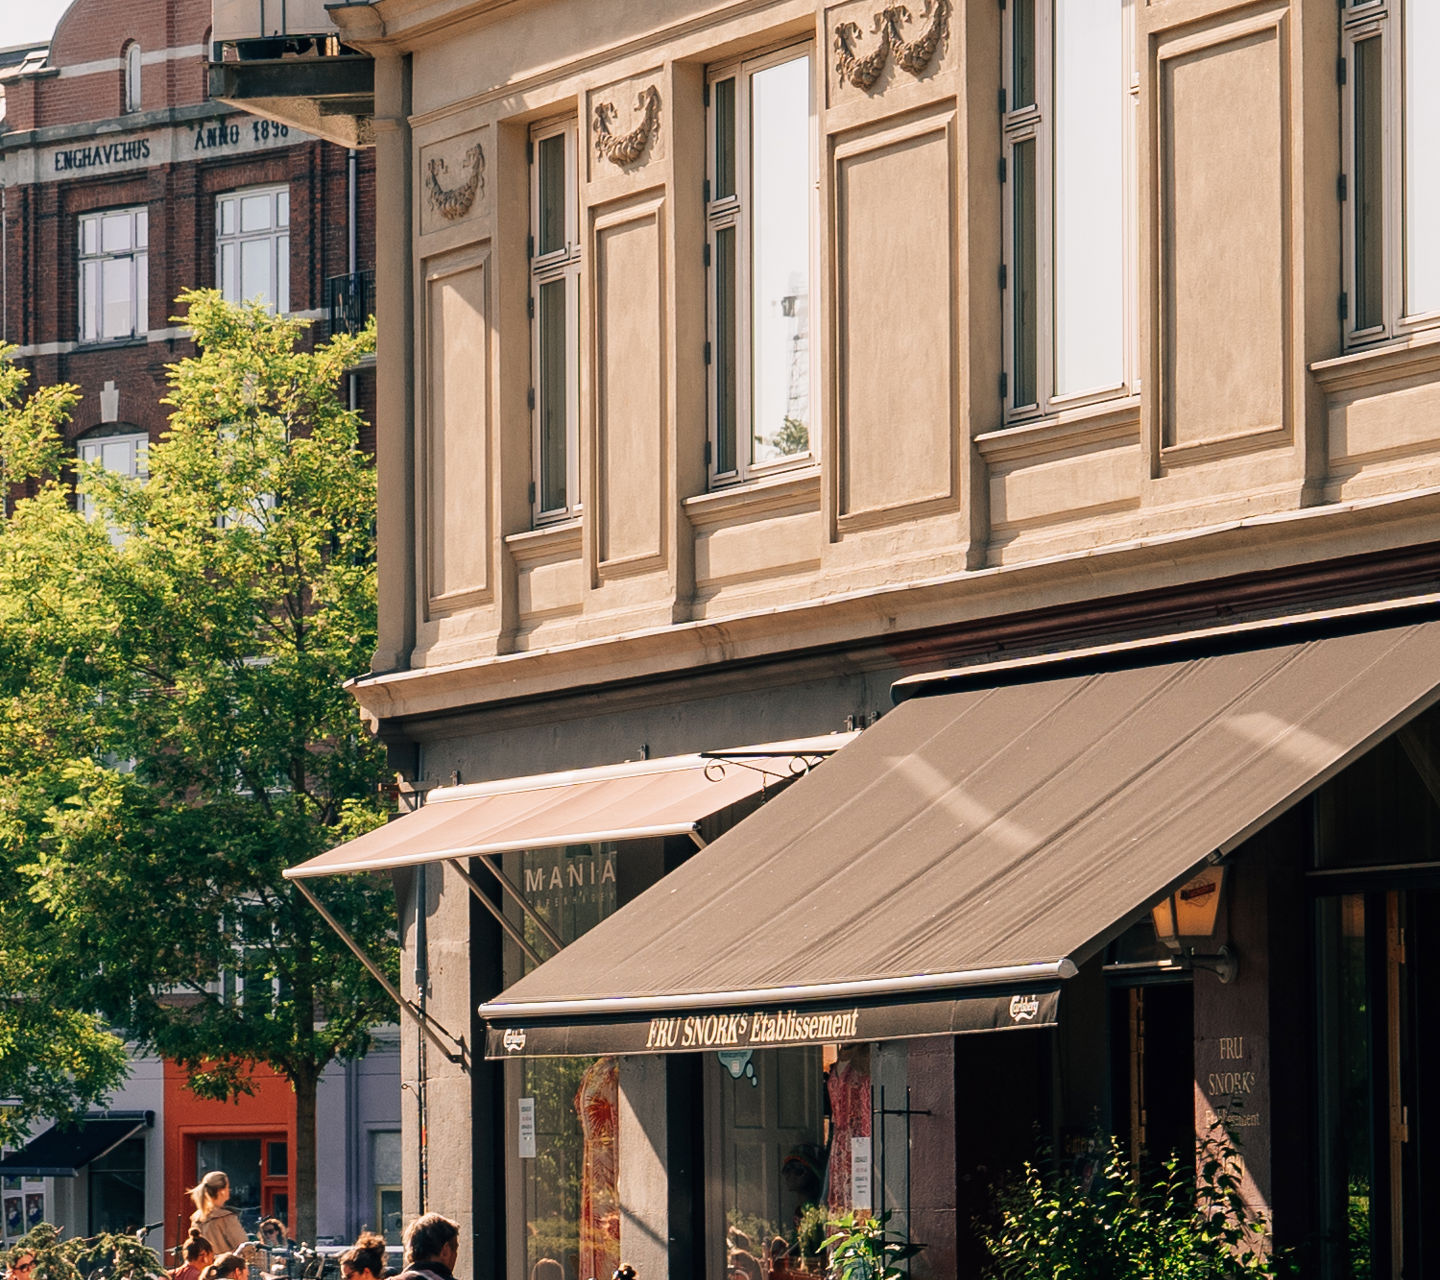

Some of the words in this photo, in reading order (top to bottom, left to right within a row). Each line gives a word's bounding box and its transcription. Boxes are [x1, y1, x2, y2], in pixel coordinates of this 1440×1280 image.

[194, 124, 239, 150] ANNO
[54, 138, 151, 171] ENGHAVEHUS
[524, 859, 617, 893] MANIA
[646, 1016, 682, 1048] FRU
[749, 1007, 859, 1043] Etablissement
[1219, 1036, 1244, 1060] FRU
